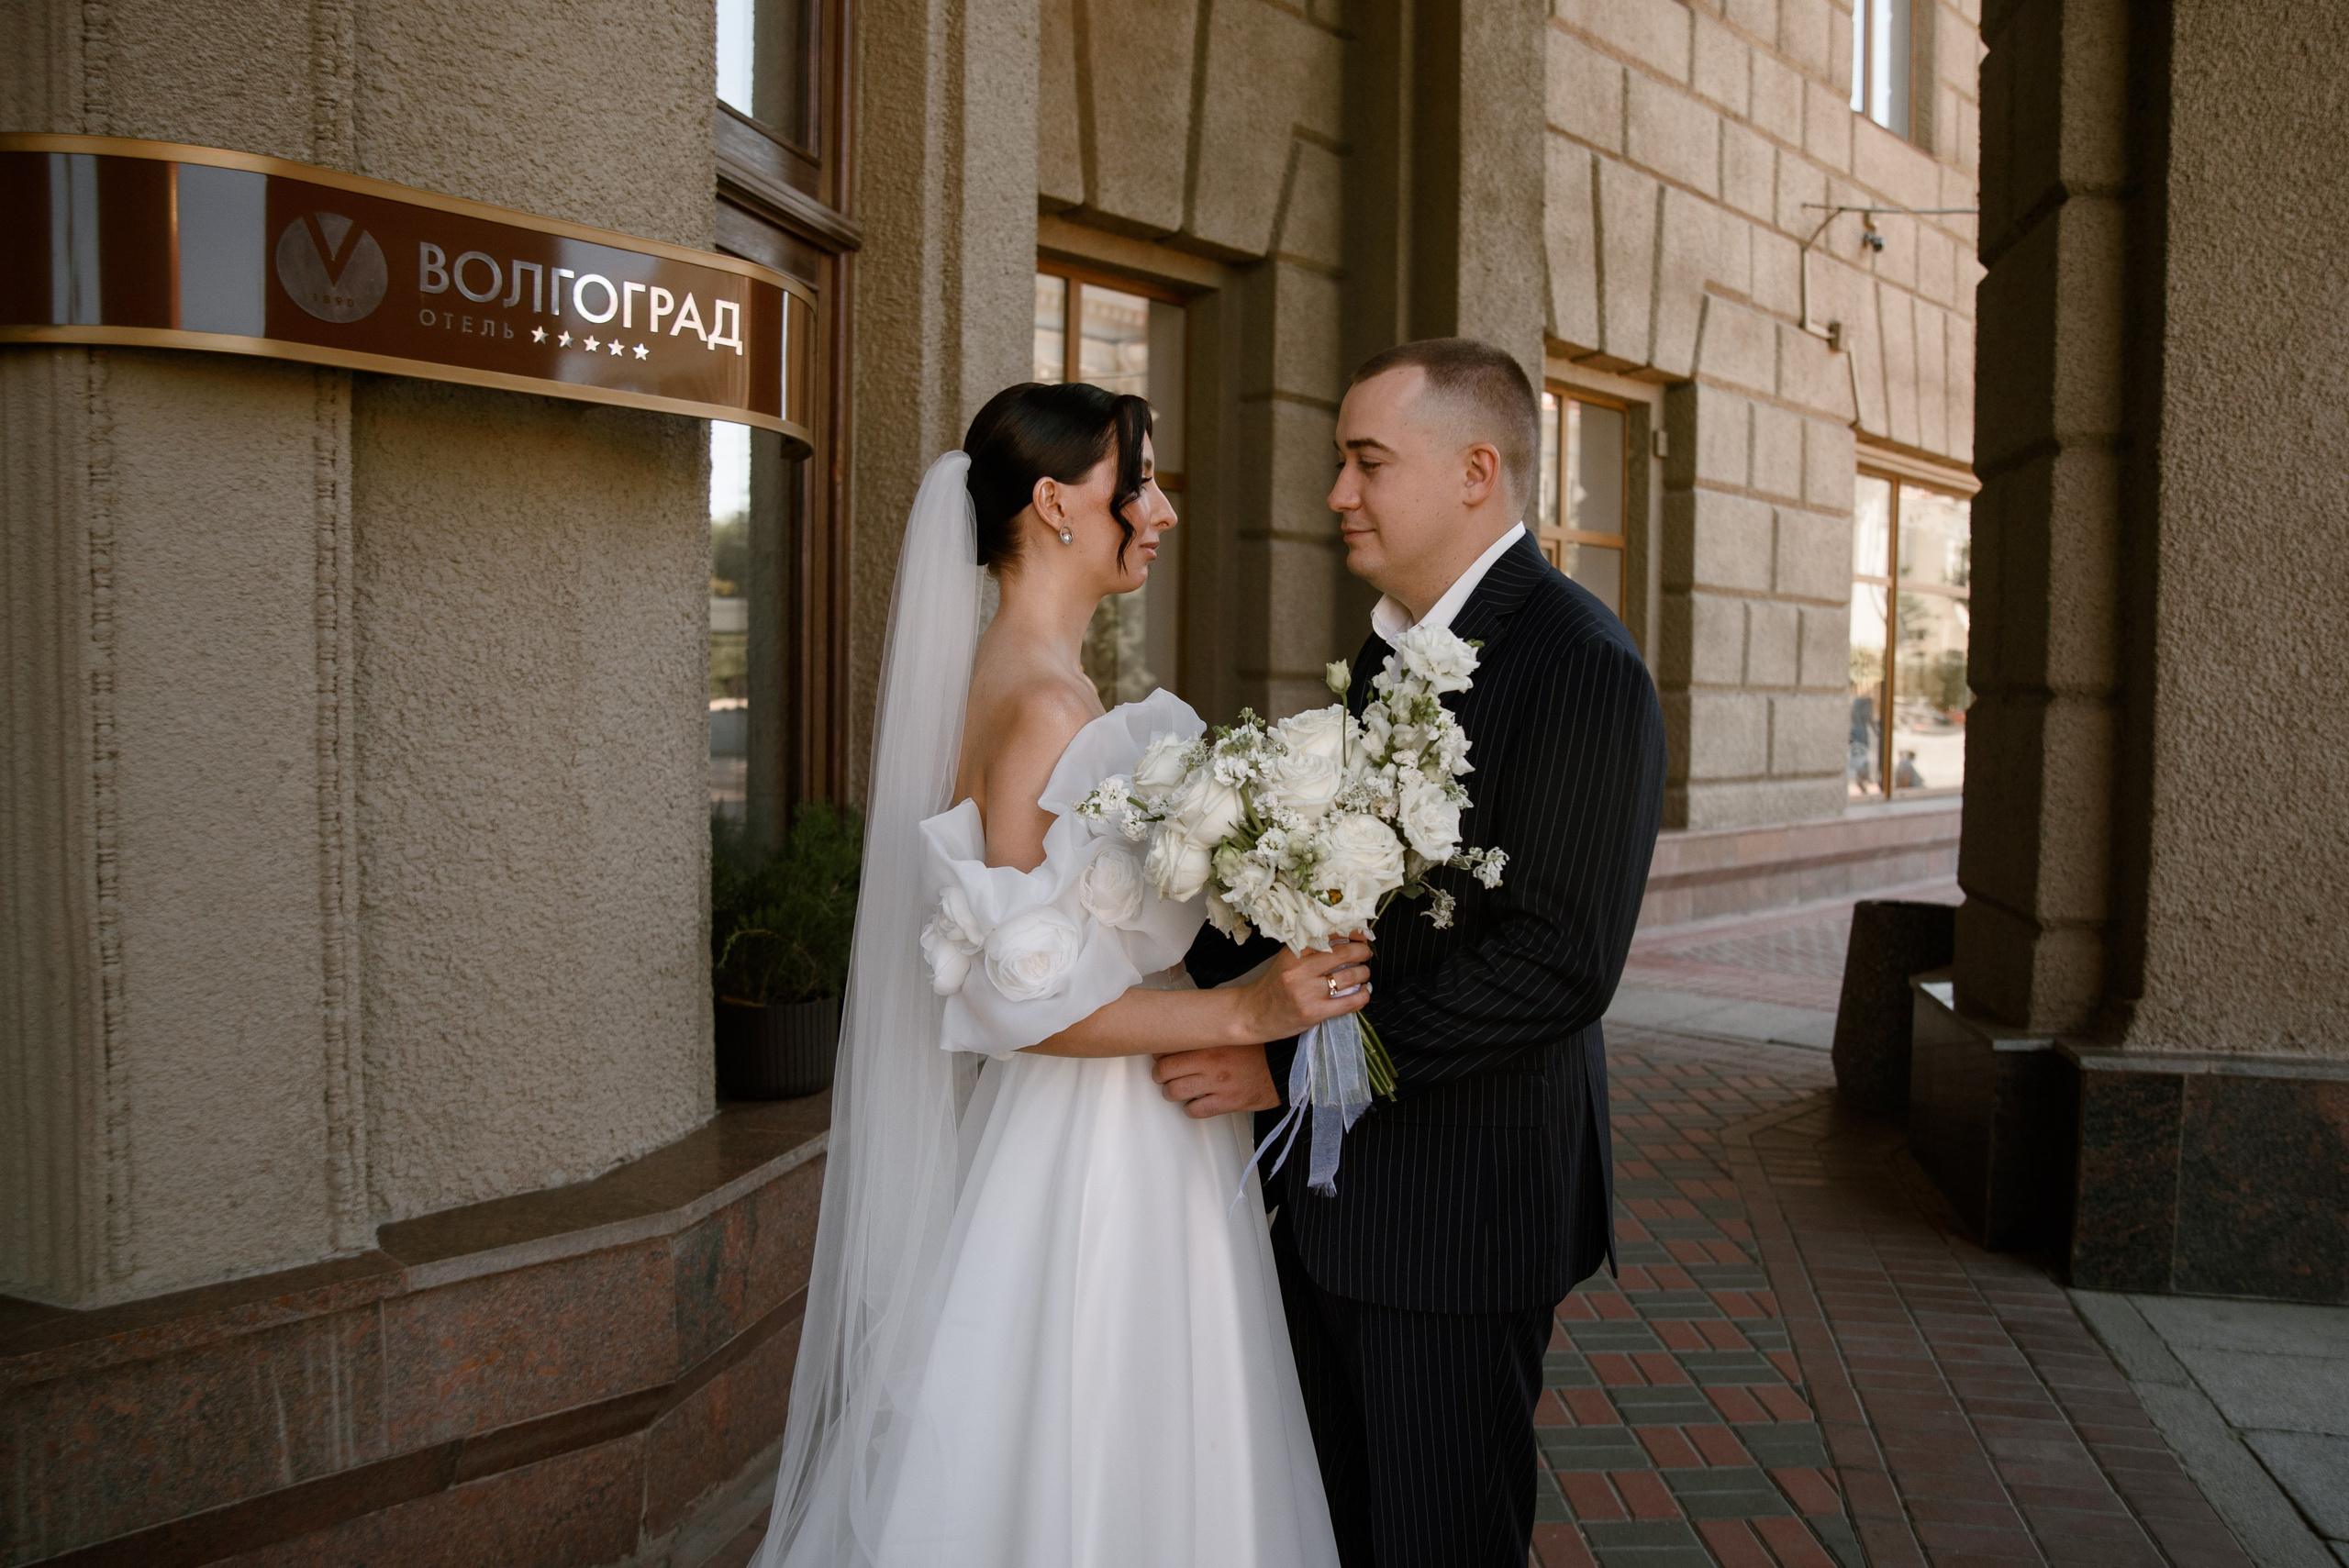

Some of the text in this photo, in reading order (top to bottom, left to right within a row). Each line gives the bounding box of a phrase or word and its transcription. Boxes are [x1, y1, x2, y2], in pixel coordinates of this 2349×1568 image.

[313, 293, 355, 308] 1890
[419, 241, 742, 355] ВОЛГОГРАД
[419, 308, 514, 339] ОТЕЛЬ
